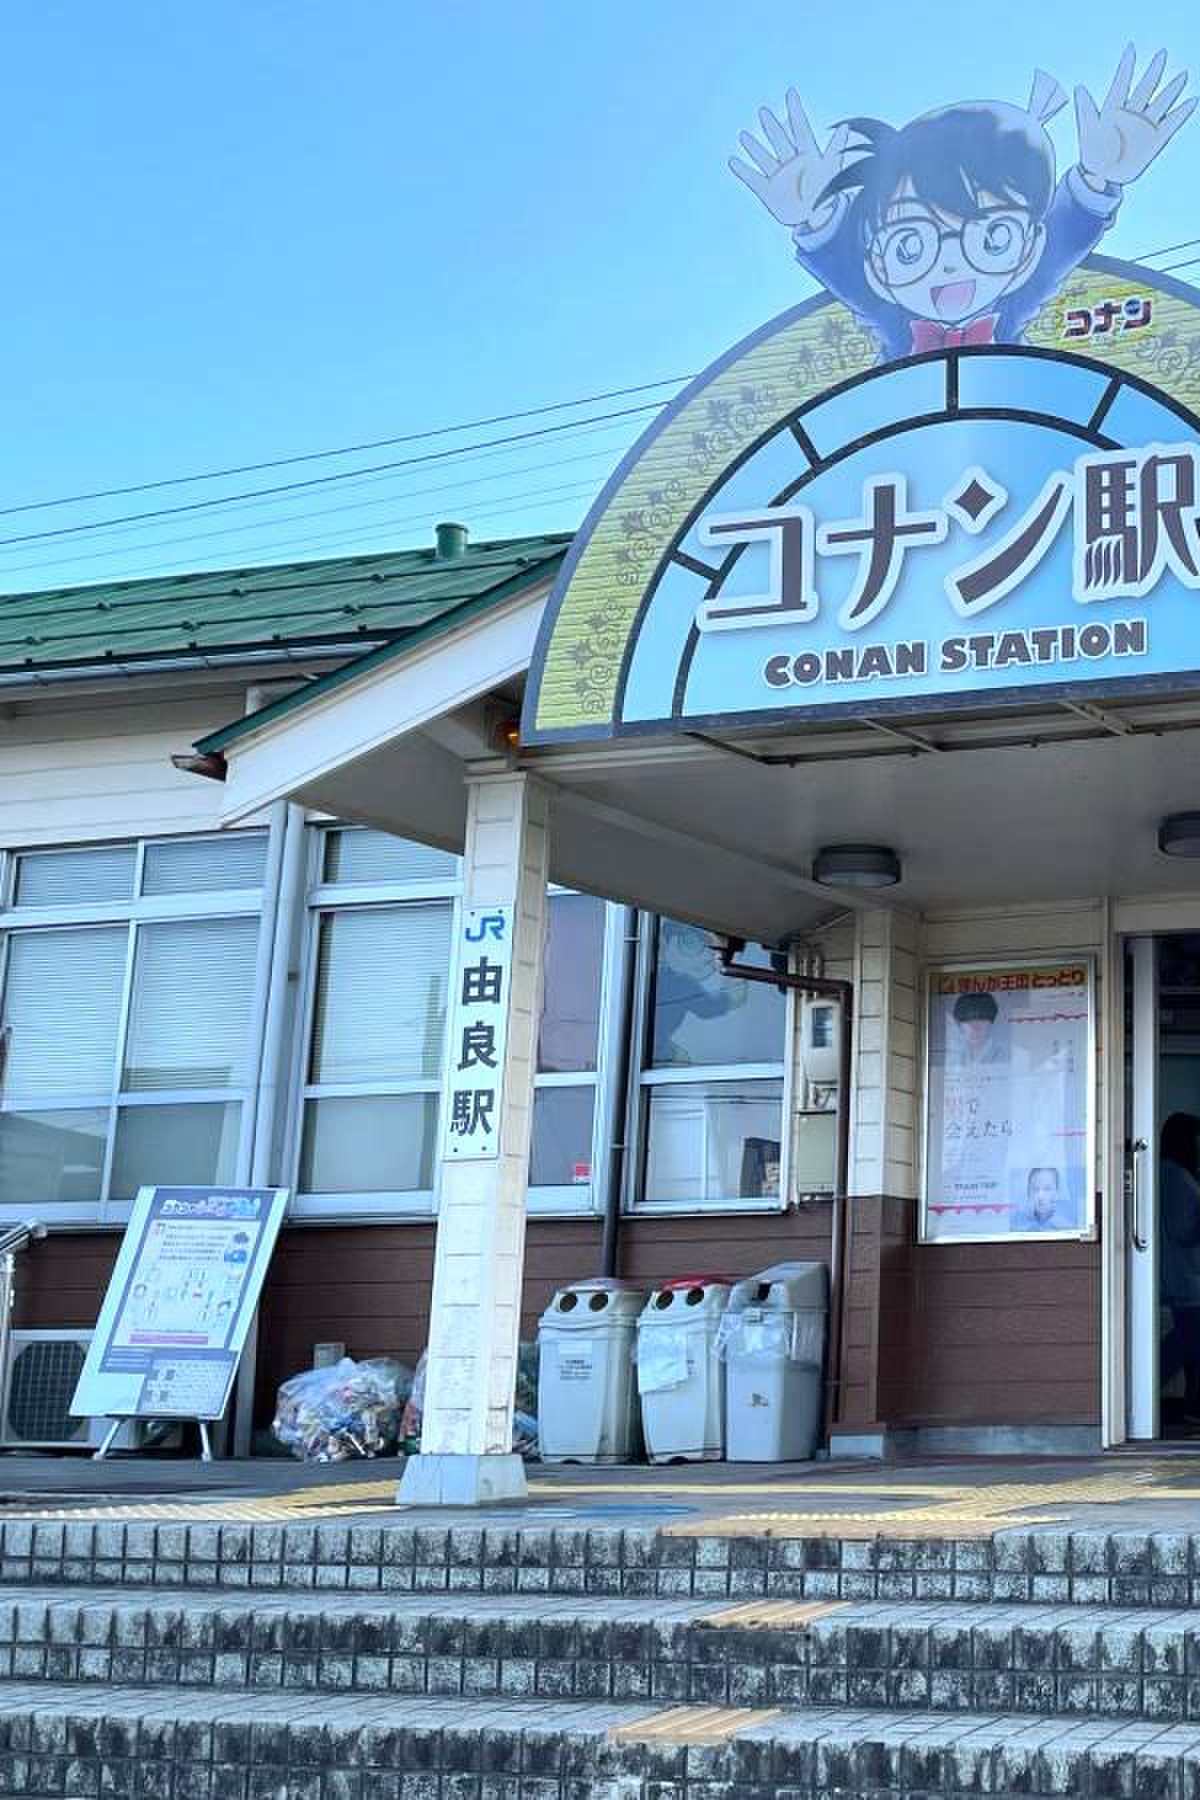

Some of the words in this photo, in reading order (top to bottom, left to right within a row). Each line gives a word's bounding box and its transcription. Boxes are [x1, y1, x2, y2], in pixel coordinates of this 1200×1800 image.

[1063, 299, 1153, 338] コナン
[764, 641, 926, 688] CONAN
[941, 620, 1145, 671] STATION
[464, 915, 506, 943] JR
[449, 955, 503, 1137] 由良駅
